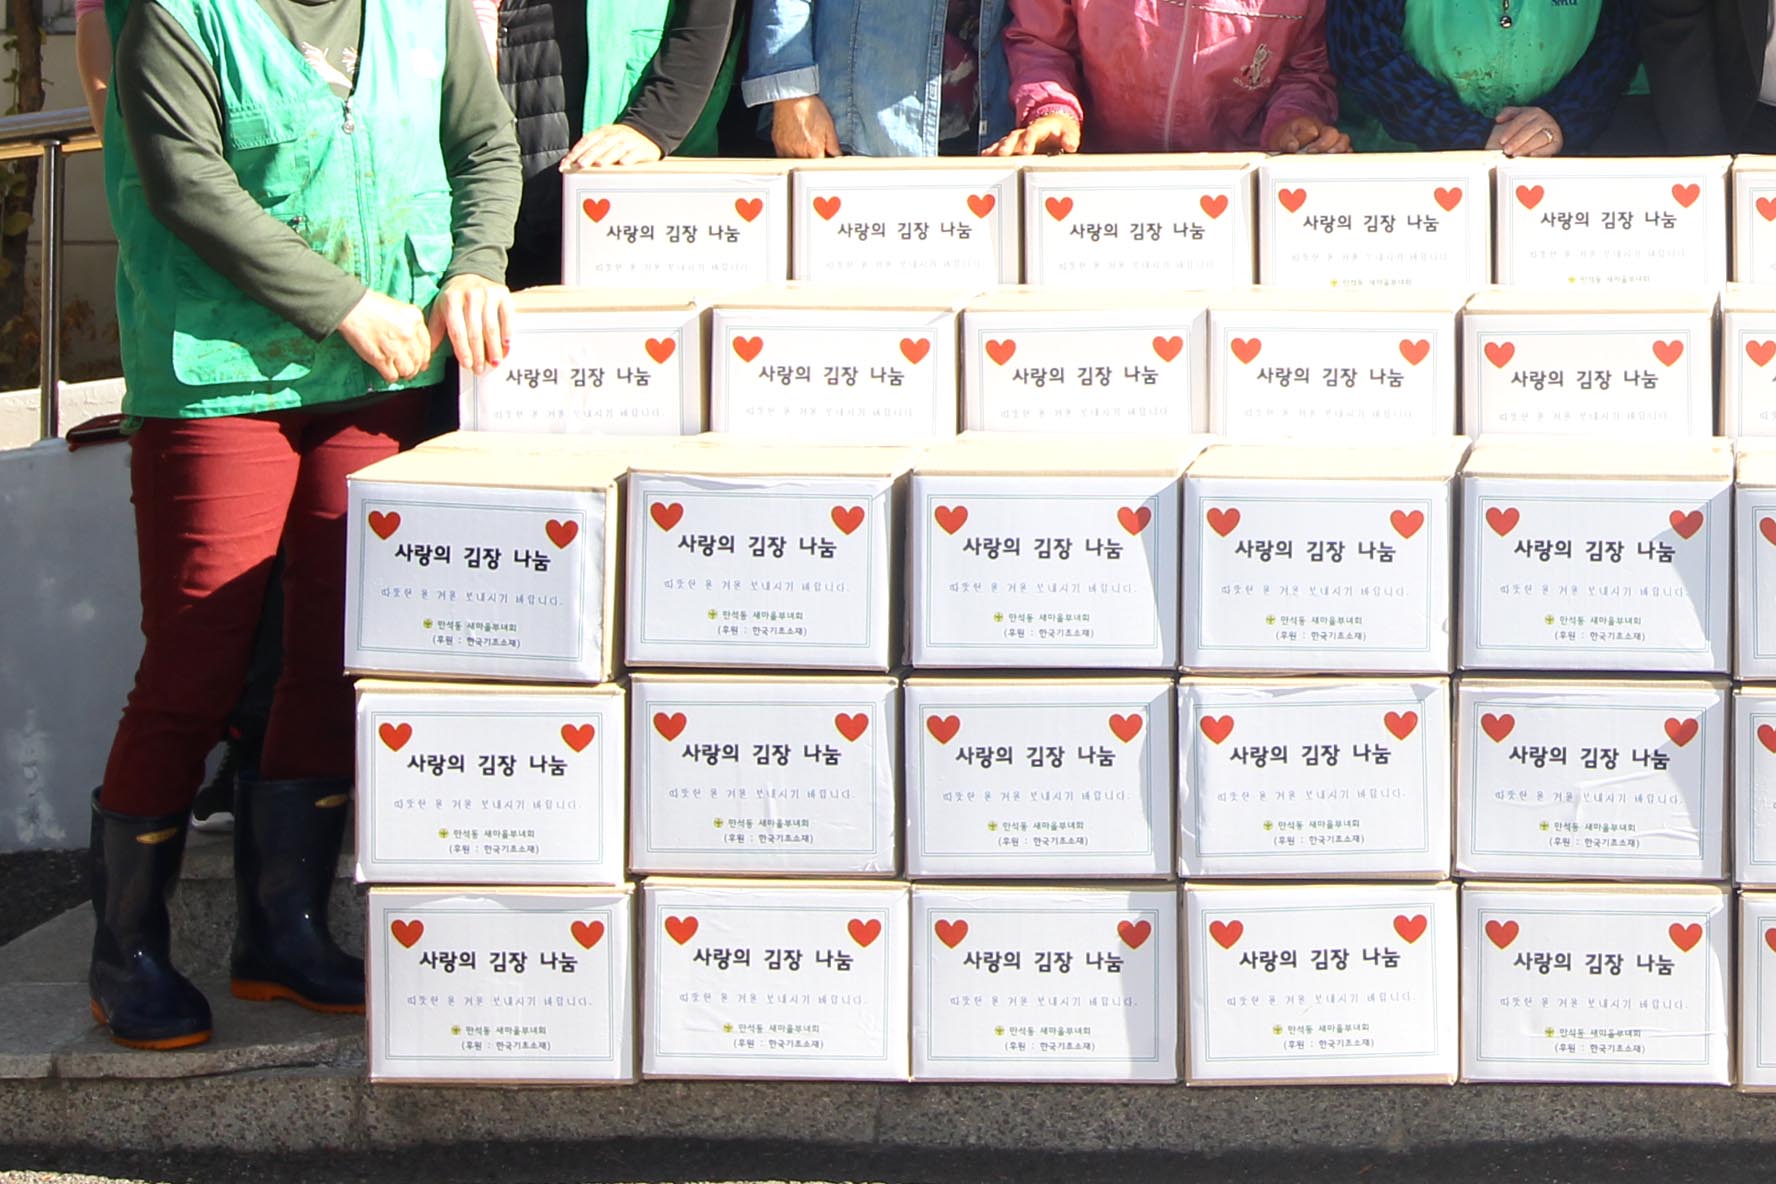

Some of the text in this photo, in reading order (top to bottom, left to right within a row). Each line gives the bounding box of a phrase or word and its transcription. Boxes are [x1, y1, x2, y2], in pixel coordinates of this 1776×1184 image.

[1069, 222, 1206, 242] 사랑의 김장 나눔
[1540, 210, 1677, 231] 사랑의 김장 나눔
[606, 224, 741, 244] 사랑의 김장 나눔
[505, 367, 651, 389] 사랑의 김장 나눔
[758, 365, 905, 387] 사랑의 김장 나눔
[1256, 367, 1405, 389] 사랑의 김장 나눔
[394, 543, 551, 572] 사랑의 김장 나눔
[677, 534, 837, 559] 사랑의 김장 나눔
[1234, 539, 1397, 564] 사랑의 김장 나눔
[407, 754, 568, 777] 사랑의 김장 나눔
[681, 743, 842, 767] 사랑의 김장 나눔
[1229, 743, 1392, 769] 사랑의 김장 나눔
[419, 951, 578, 974] 사랑의 김장 나눔
[692, 947, 854, 972] 사랑의 김장 나눔
[1239, 947, 1401, 973] 사랑의 김장 나눔
